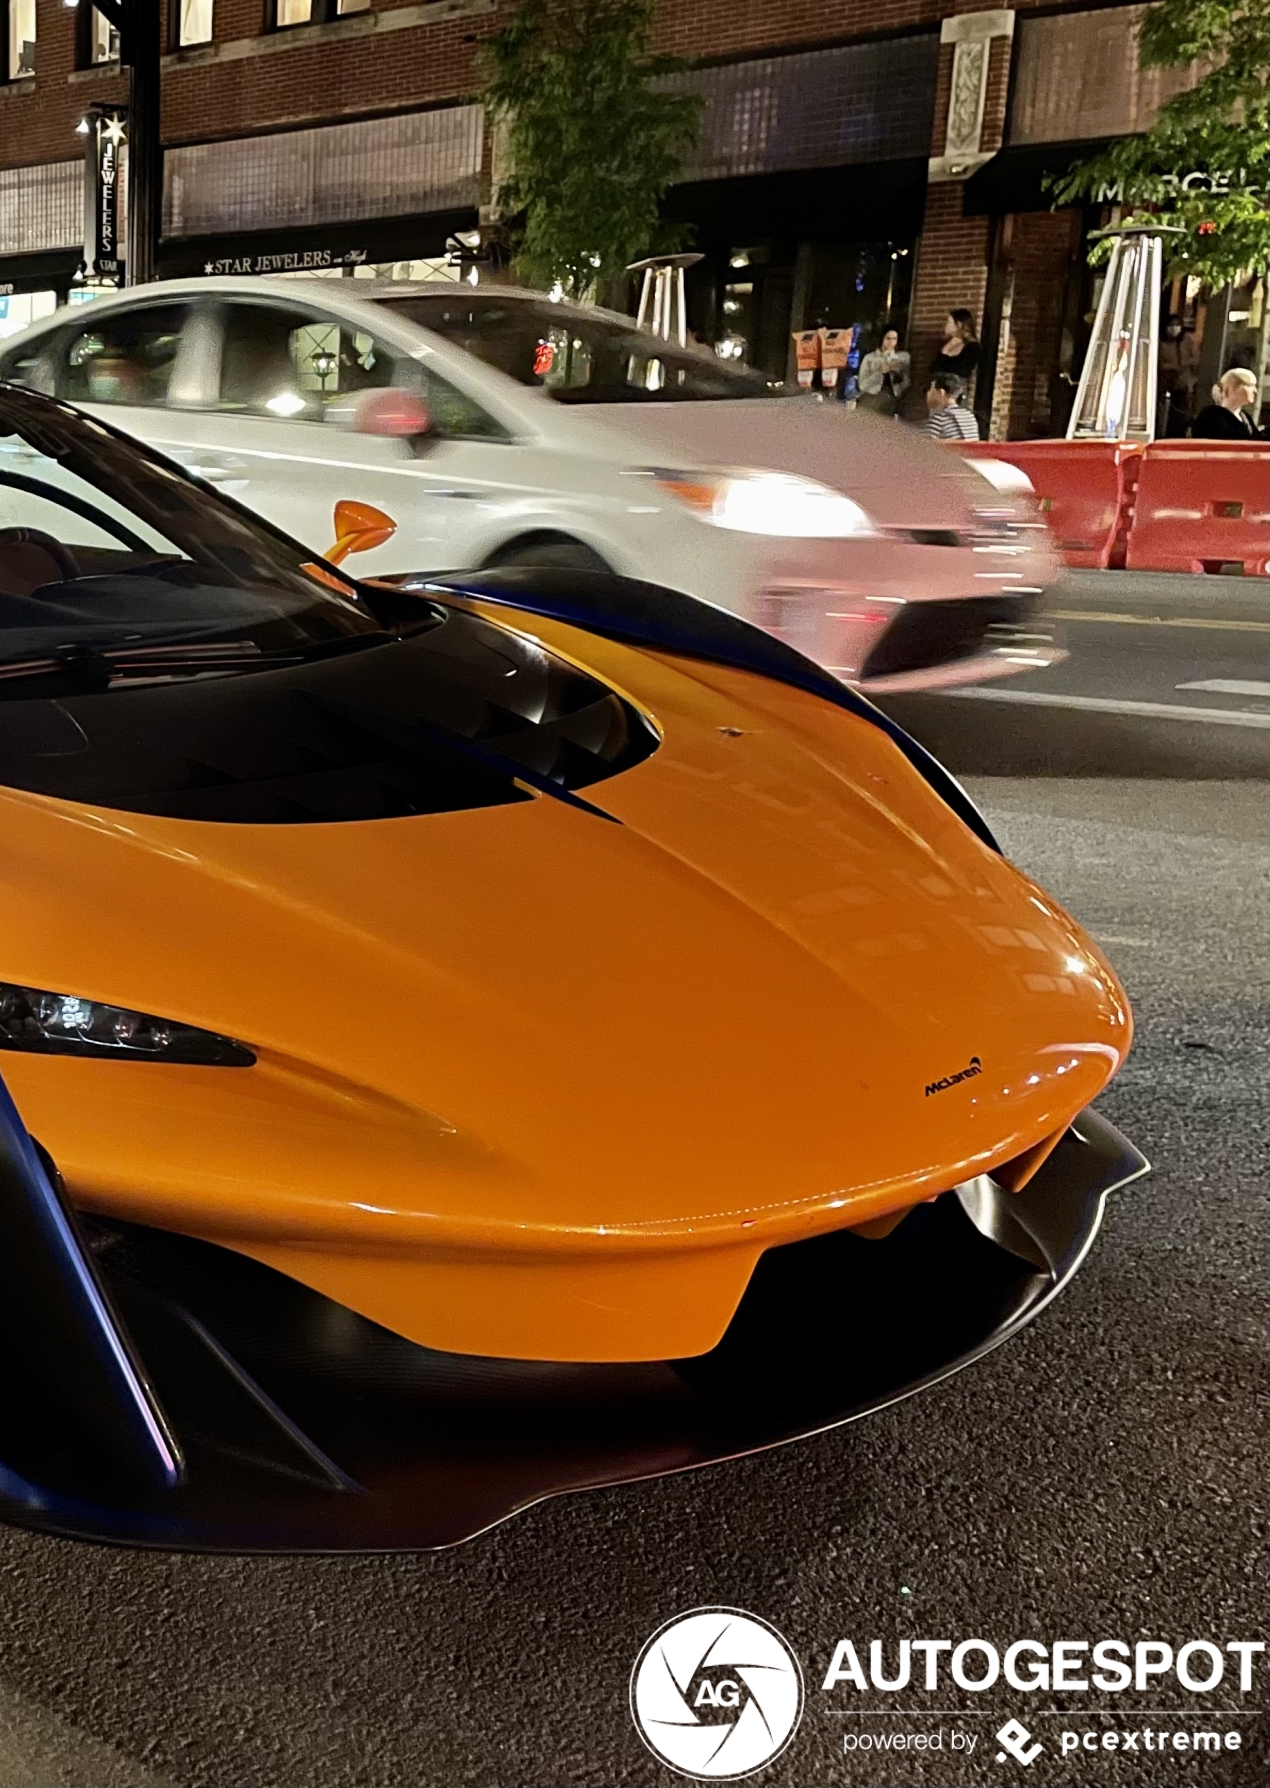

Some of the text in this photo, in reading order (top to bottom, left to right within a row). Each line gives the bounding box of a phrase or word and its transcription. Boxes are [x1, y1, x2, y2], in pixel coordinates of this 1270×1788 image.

[101, 143, 115, 251] JEWELERS
[100, 260, 118, 272] STAR
[215, 257, 251, 274] STAR
[255, 250, 331, 271] JEWELERS
[925, 1066, 982, 1097] McLaren
